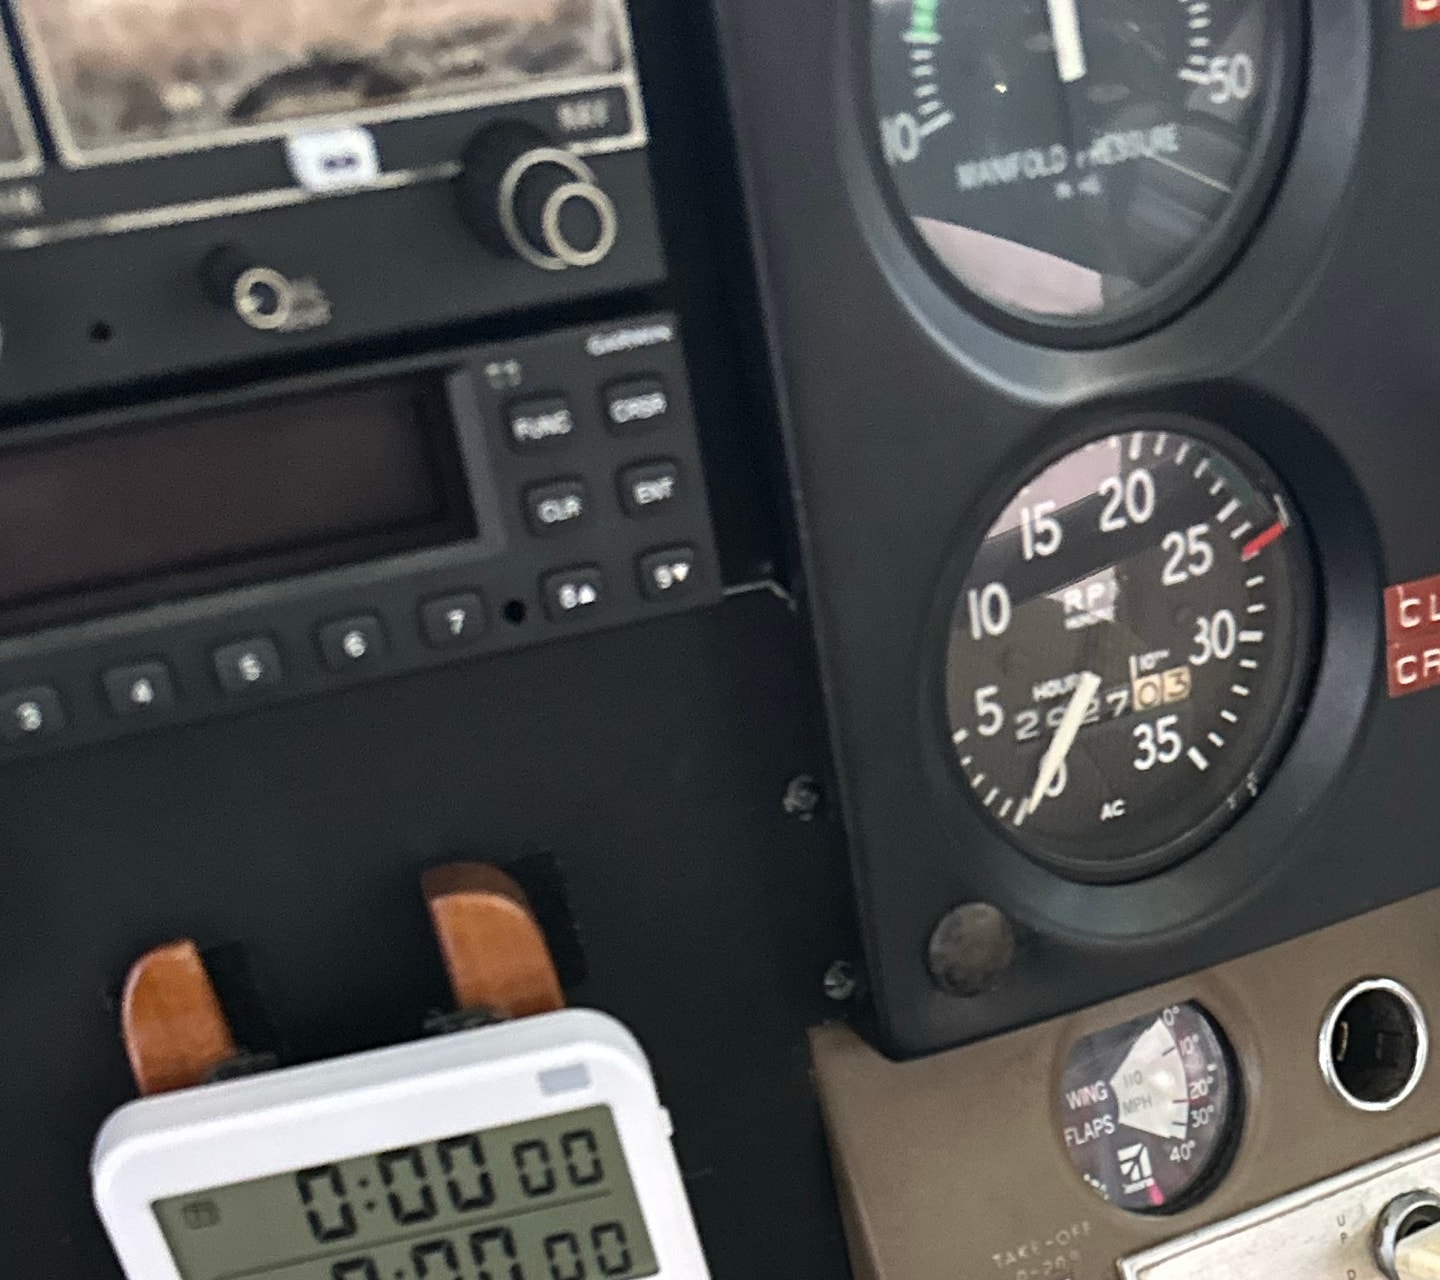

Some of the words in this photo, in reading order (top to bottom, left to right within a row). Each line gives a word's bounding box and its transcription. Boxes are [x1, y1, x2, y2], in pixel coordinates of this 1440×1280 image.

[1206, 53, 1254, 104] 50
[1099, 468, 1156, 533] 20
[1019, 500, 1062, 560] 15
[1160, 524, 1214, 586] 25
[968, 583, 1013, 640] 10
[1188, 609, 1237, 666] 30
[974, 686, 1004, 736] 5
[1132, 714, 1183, 771] 35
[1100, 799, 1127, 821] AC
[1065, 1080, 1109, 1110] WING
[1122, 1097, 1153, 1115] MPH
[1063, 1114, 1116, 1147] FLAPS
[294, 1134, 497, 1245] 0:00
[512, 1128, 607, 1198] 00
[1336, 1213, 1349, 1244] UP
